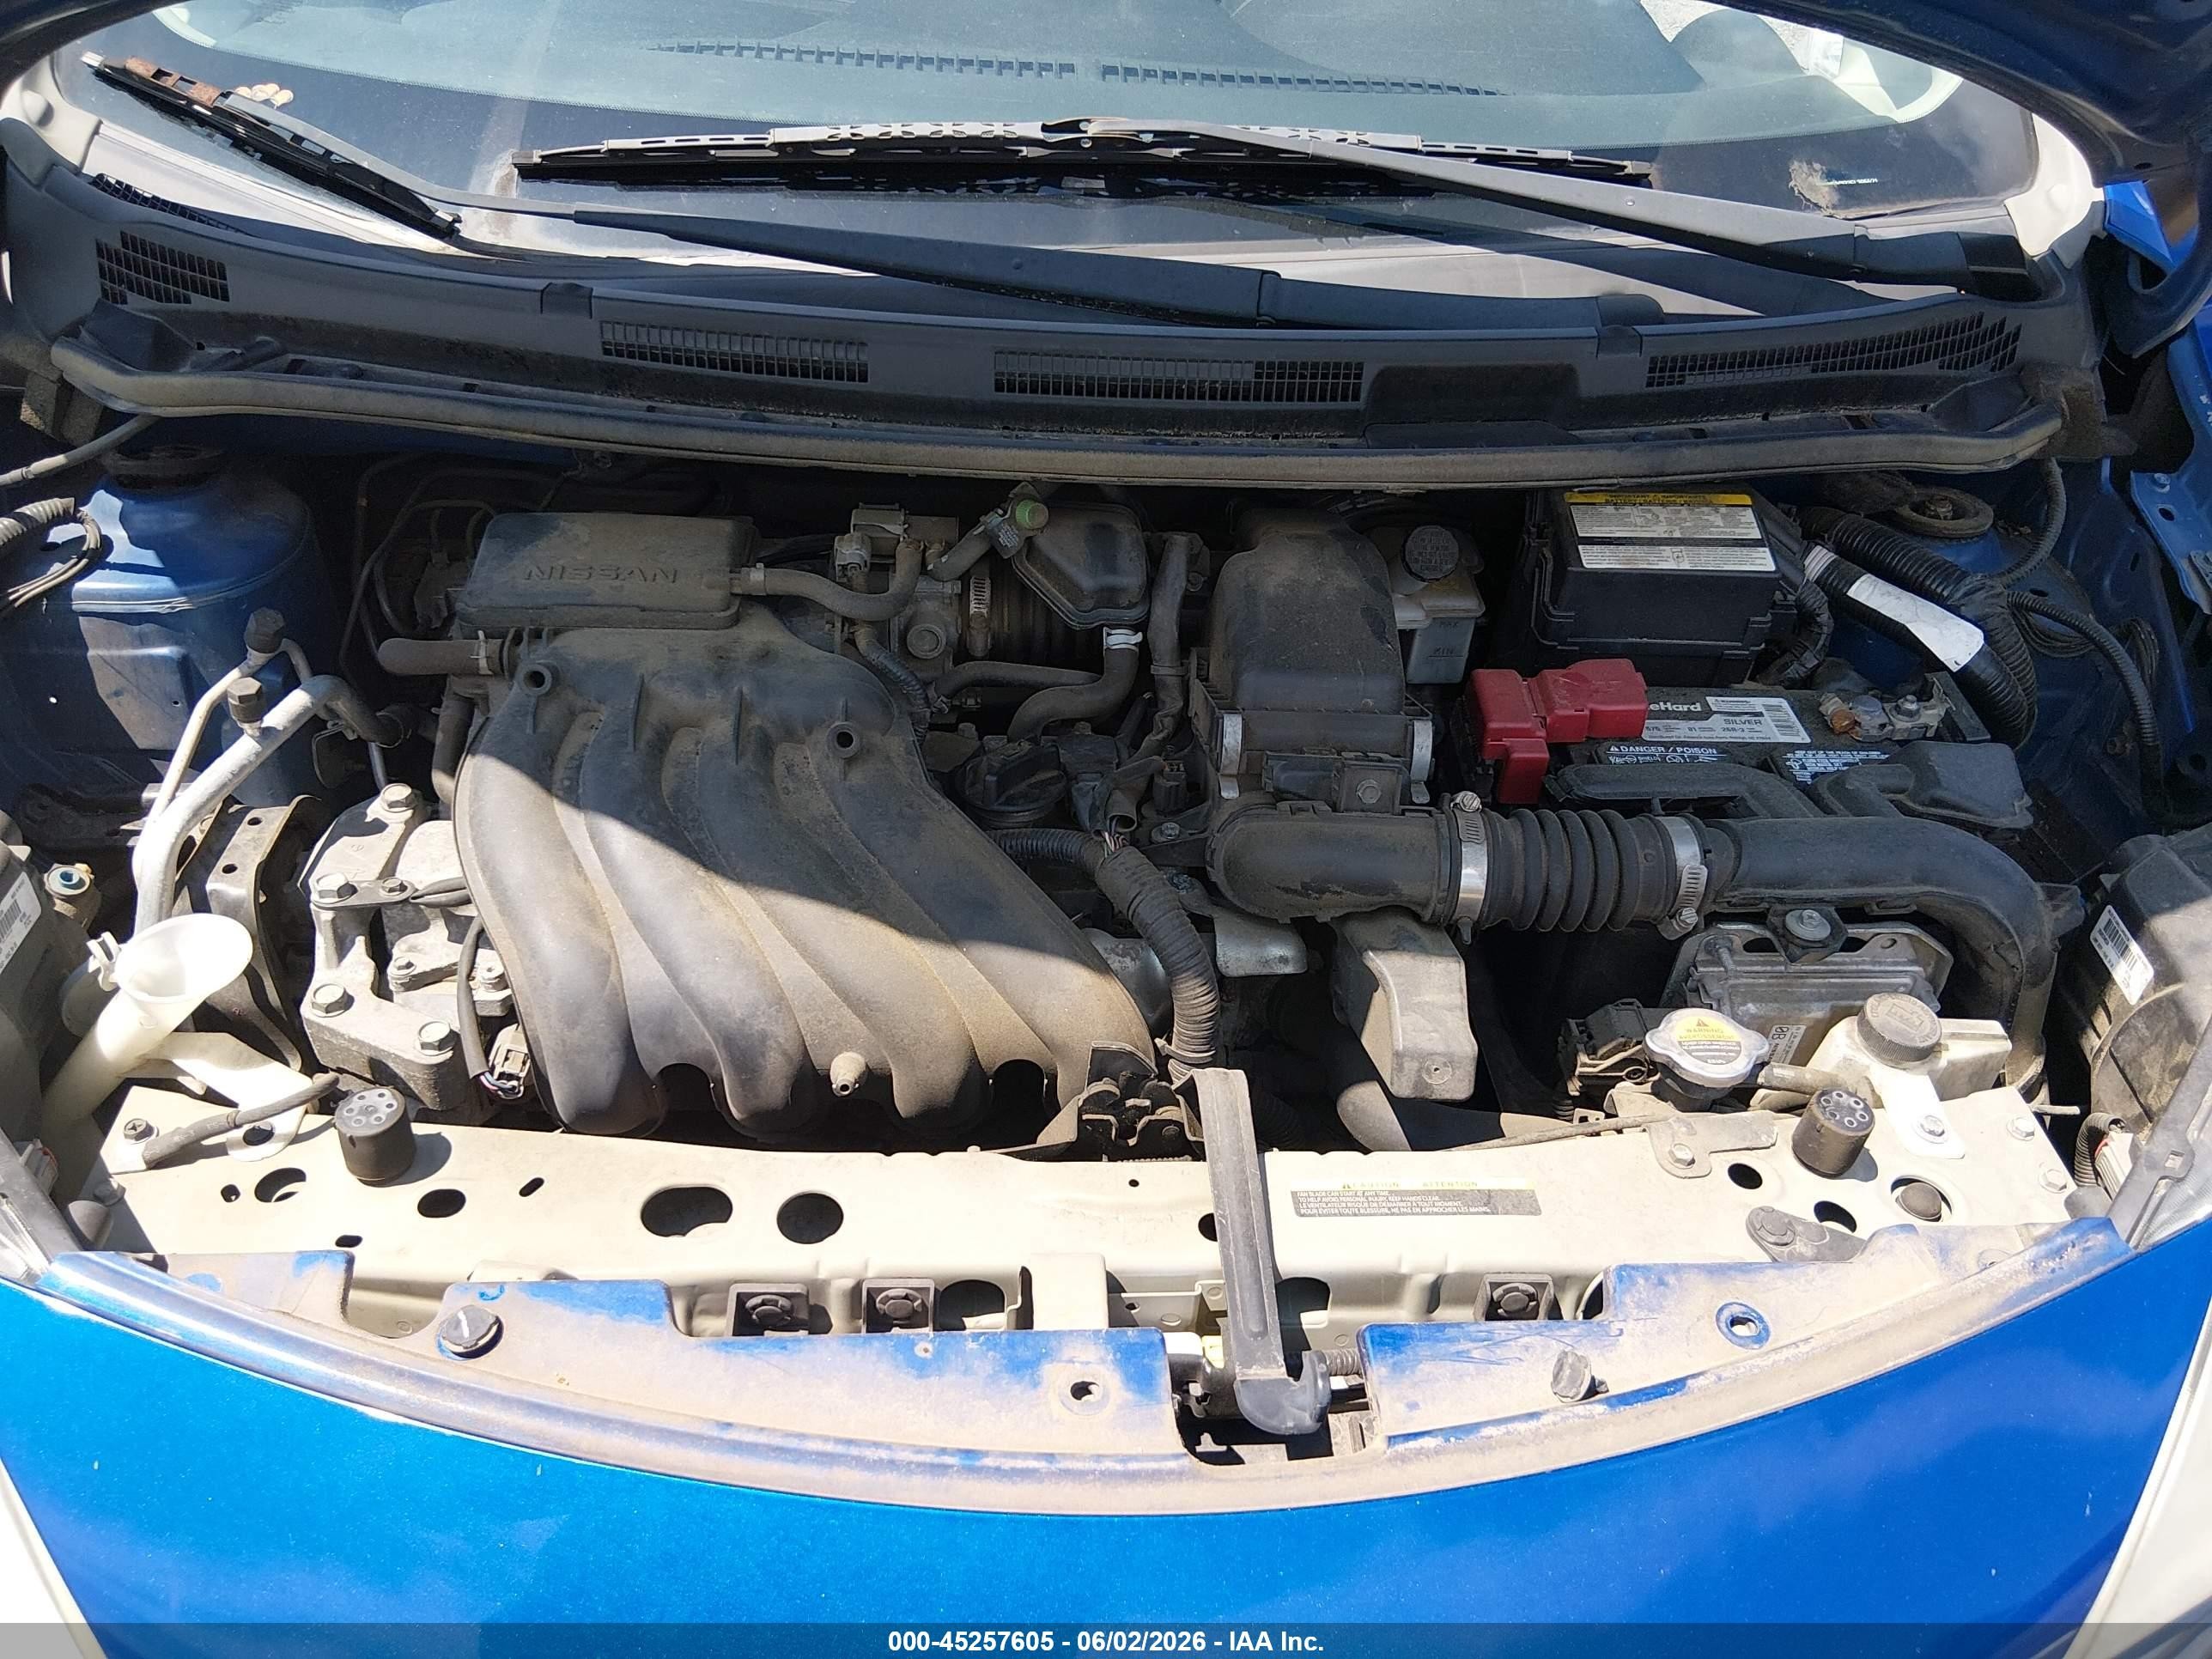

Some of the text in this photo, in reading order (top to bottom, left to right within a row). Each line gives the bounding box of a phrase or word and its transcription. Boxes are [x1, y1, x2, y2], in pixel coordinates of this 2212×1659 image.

[524, 565, 678, 584] NISSAN
[1648, 702, 1702, 712] eHard
[1723, 718, 1763, 726] SILVER
